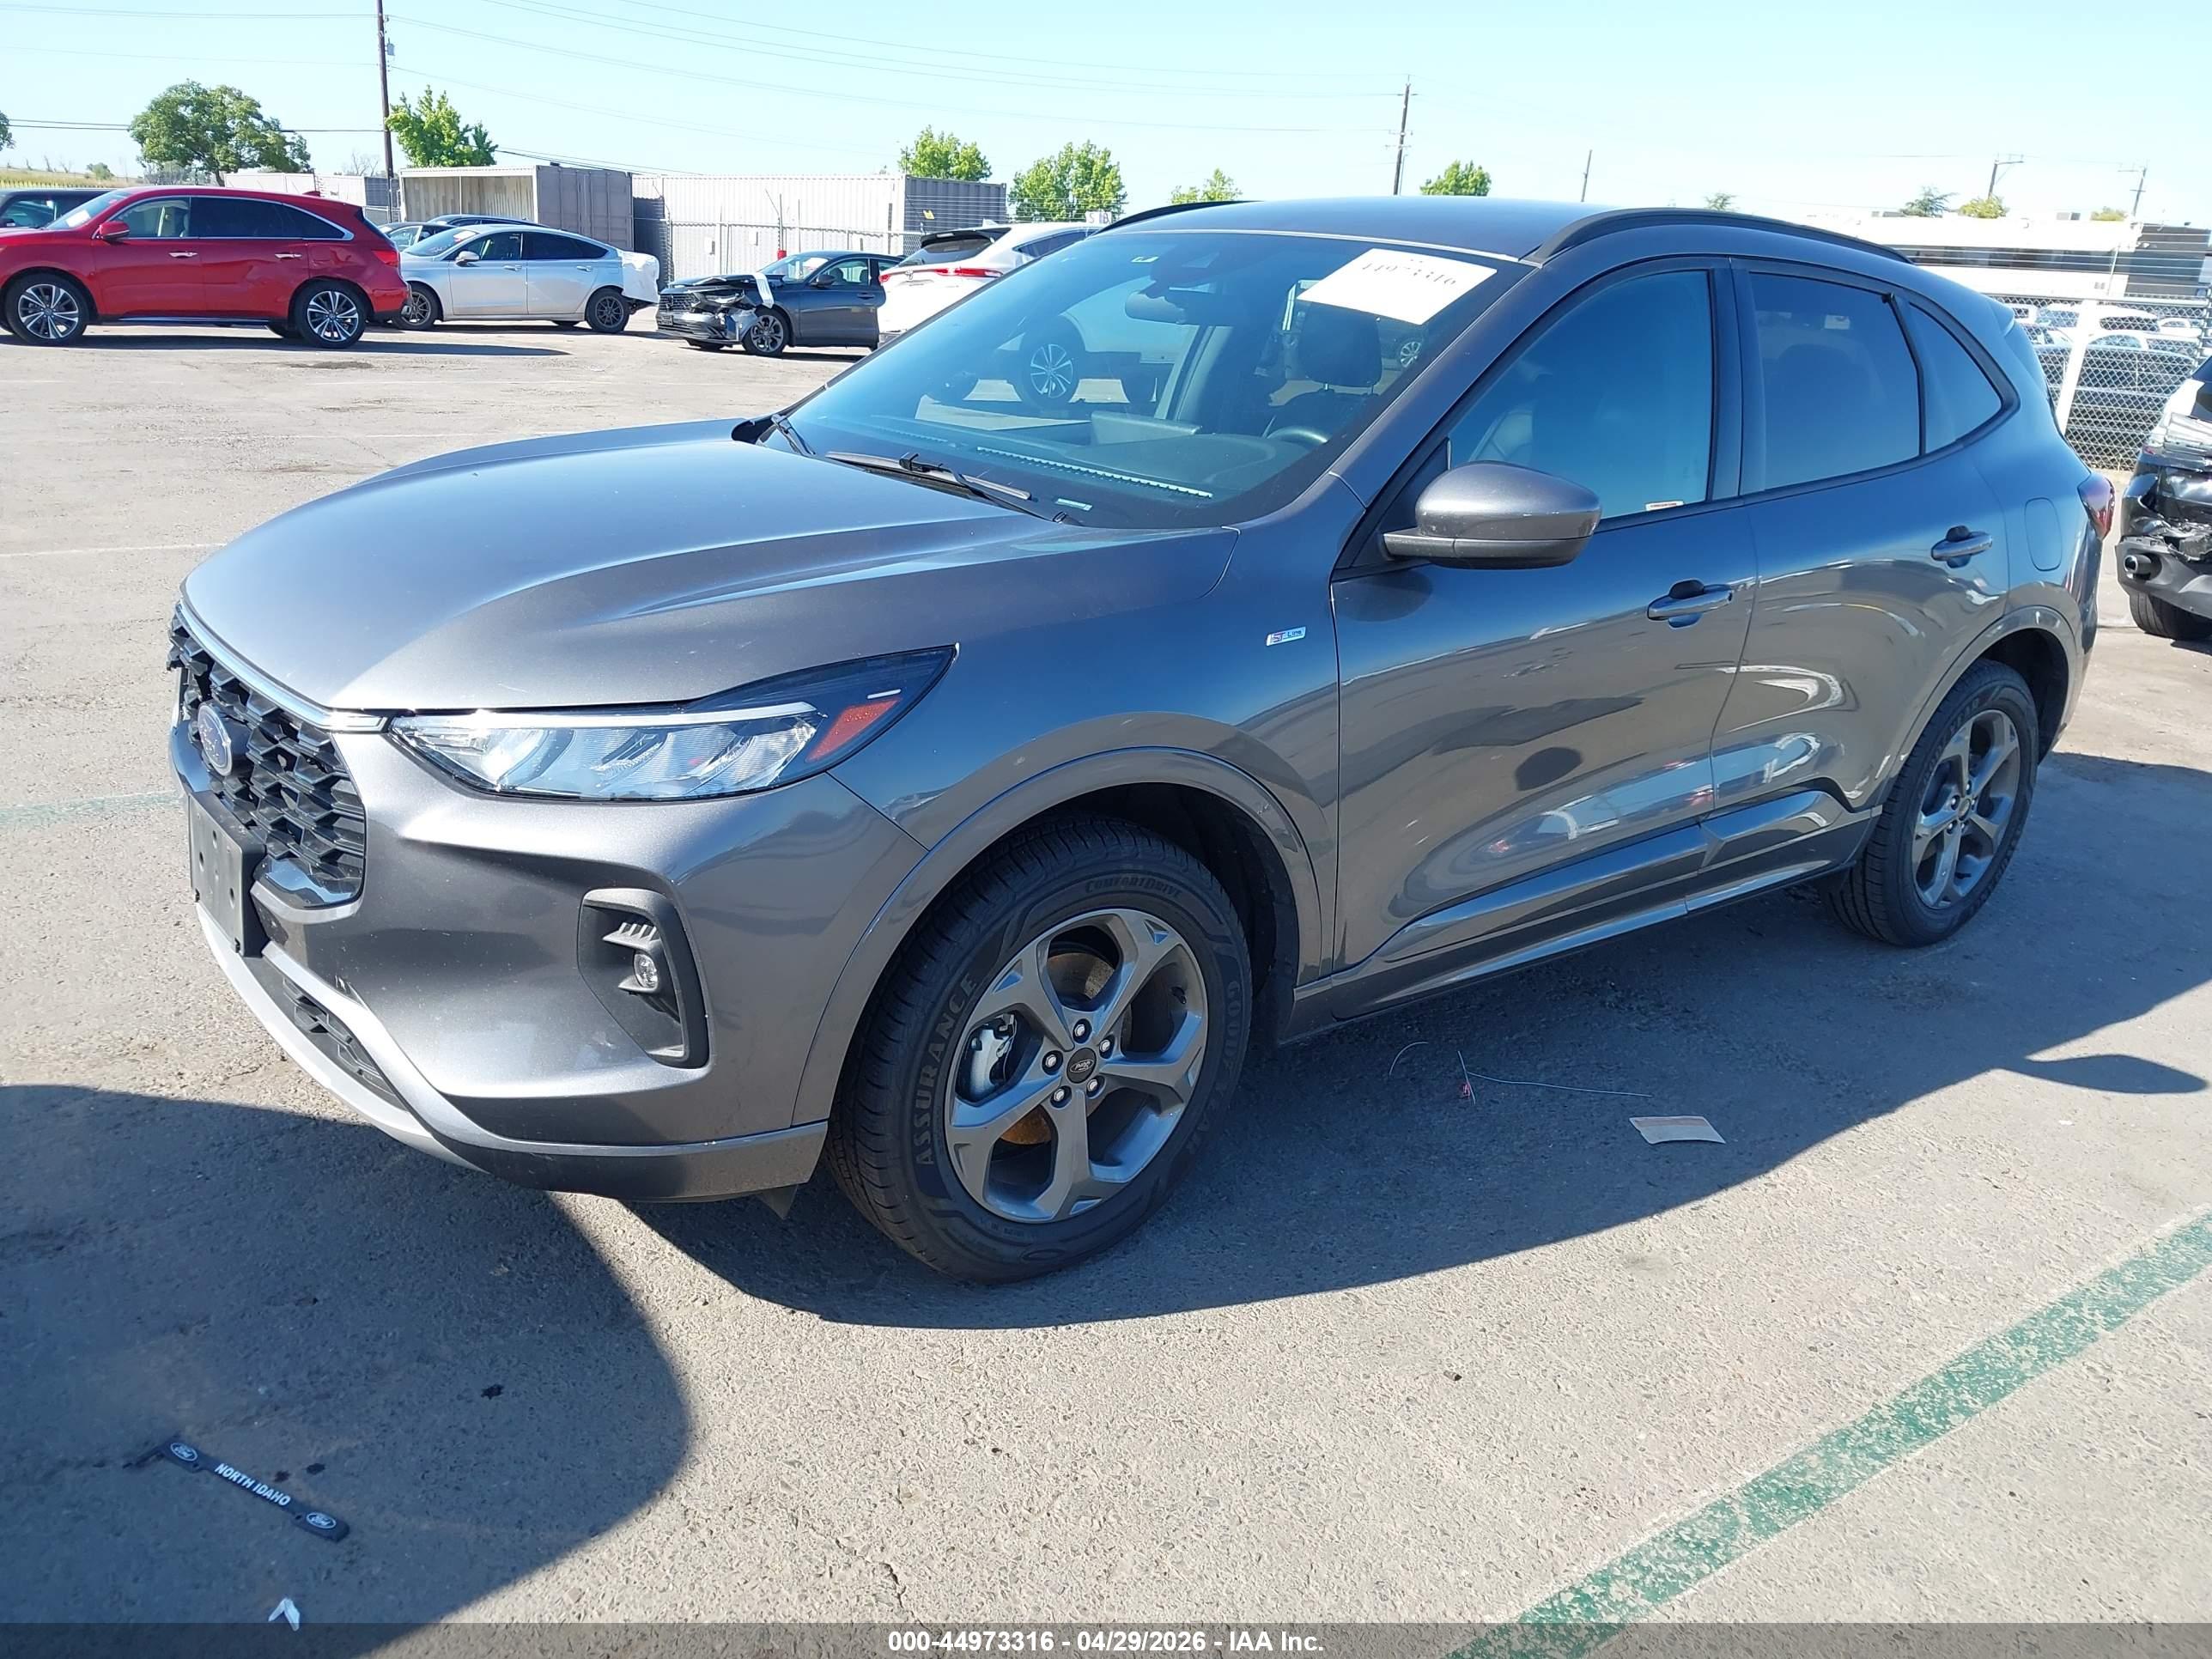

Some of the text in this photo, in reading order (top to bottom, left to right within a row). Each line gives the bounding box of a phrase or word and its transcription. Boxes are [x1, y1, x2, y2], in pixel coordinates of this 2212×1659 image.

[913, 971, 977, 1165] ASSURANCE
[214, 1462, 291, 1506] NORTH IDAHO
